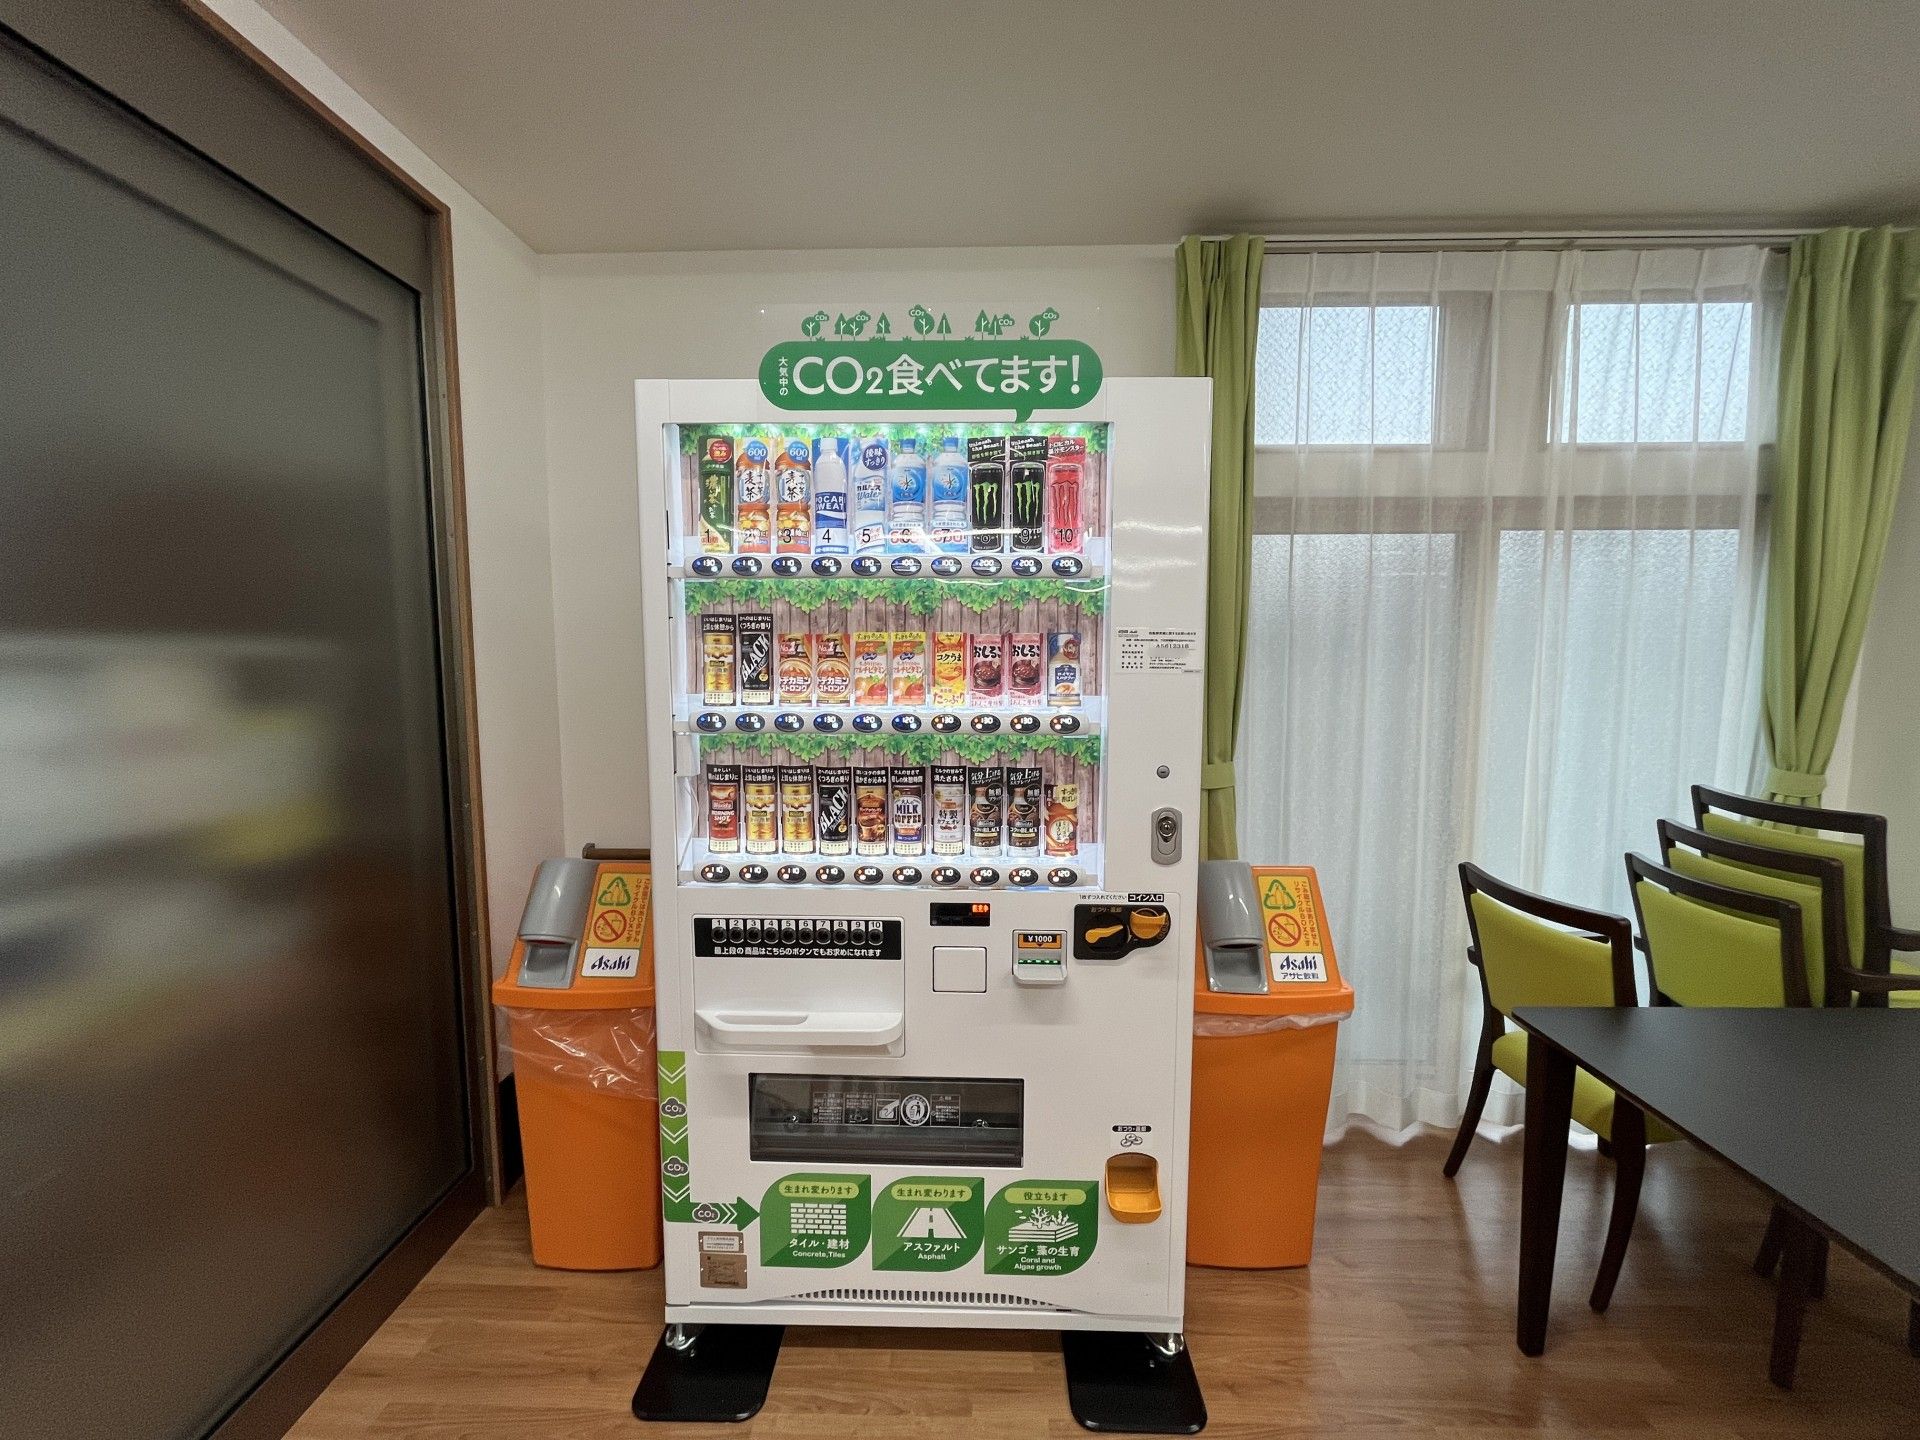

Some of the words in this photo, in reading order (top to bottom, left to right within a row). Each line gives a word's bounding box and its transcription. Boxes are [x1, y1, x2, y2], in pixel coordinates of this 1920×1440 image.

[778, 356, 788, 396] 大気中の
[748, 448, 766, 457] 600
[790, 448, 808, 457] 600
[705, 530, 710, 543] 1
[782, 529, 792, 543] 3
[822, 529, 831, 543] 4
[862, 529, 871, 543] 5
[942, 529, 951, 543] 7
[1022, 528, 1030, 543] 9
[1059, 528, 1073, 542] 10
[703, 559, 715, 567] 130
[742, 559, 755, 567] 110
[782, 559, 795, 567] 110
[822, 559, 834, 567] 150
[862, 559, 874, 567] 130
[902, 559, 914, 567] 100
[941, 559, 954, 567] 100
[979, 559, 994, 567] 200
[1019, 559, 1034, 567] 200
[1059, 559, 1074, 567] 200
[742, 634, 770, 682] BLACK
[937, 653, 962, 662] コクうま
[820, 787, 849, 834] BLACK
[896, 805, 919, 814] MILK
[939, 810, 958, 819] 特製
[714, 946, 882, 957] 最上段の商品はこちらのボタンでもお求めになれます
[591, 955, 632, 971] Asahi
[1280, 955, 1317, 970] Asahi
[784, 1185, 853, 1195] 生まれ変わります
[896, 1188, 966, 1198] 生まれ変わります
[1024, 1192, 1068, 1201] 役立ちます
[789, 1238, 850, 1249] タイル・建材
[904, 1242, 960, 1252] アスファルト
[996, 1246, 1080, 1257] サンゴ・藻の生育
